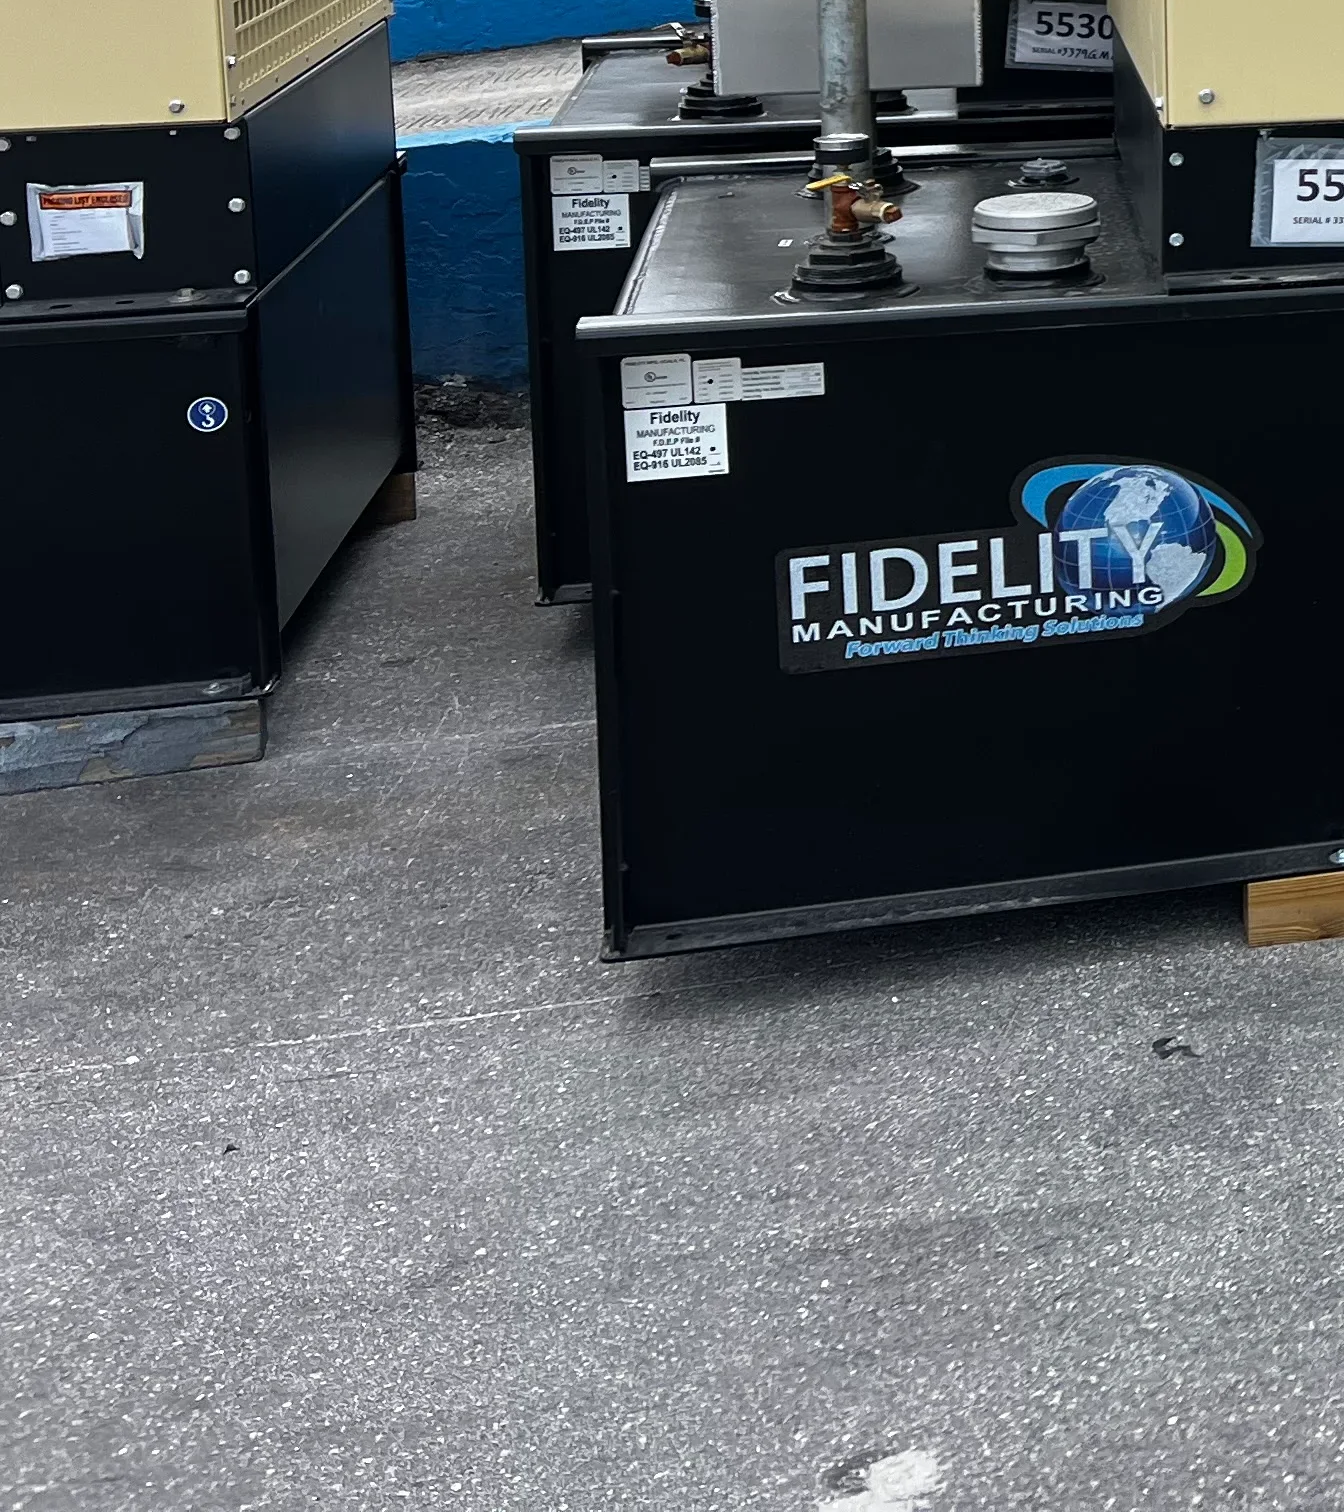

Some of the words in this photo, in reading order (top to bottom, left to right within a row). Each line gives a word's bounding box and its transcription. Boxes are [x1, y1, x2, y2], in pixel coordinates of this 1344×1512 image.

[571, 197, 610, 209] Fidelity
[1293, 216, 1323, 224] SERIAL
[1325, 216, 1331, 224] #
[587, 225, 610, 233] UL142
[650, 410, 700, 424] Fidelity
[636, 424, 716, 438] MANUFACTURING
[633, 448, 668, 460] EQ-497
[670, 446, 702, 457] UL142
[633, 460, 669, 471] EQ-916
[671, 456, 708, 468] UL2085
[788, 521, 1164, 621] FIDELITY
[791, 586, 1165, 644] MANUFACTURING
[845, 633, 940, 659] Forward
[942, 623, 1038, 648] Thinking
[1042, 613, 1144, 637] Solutions
